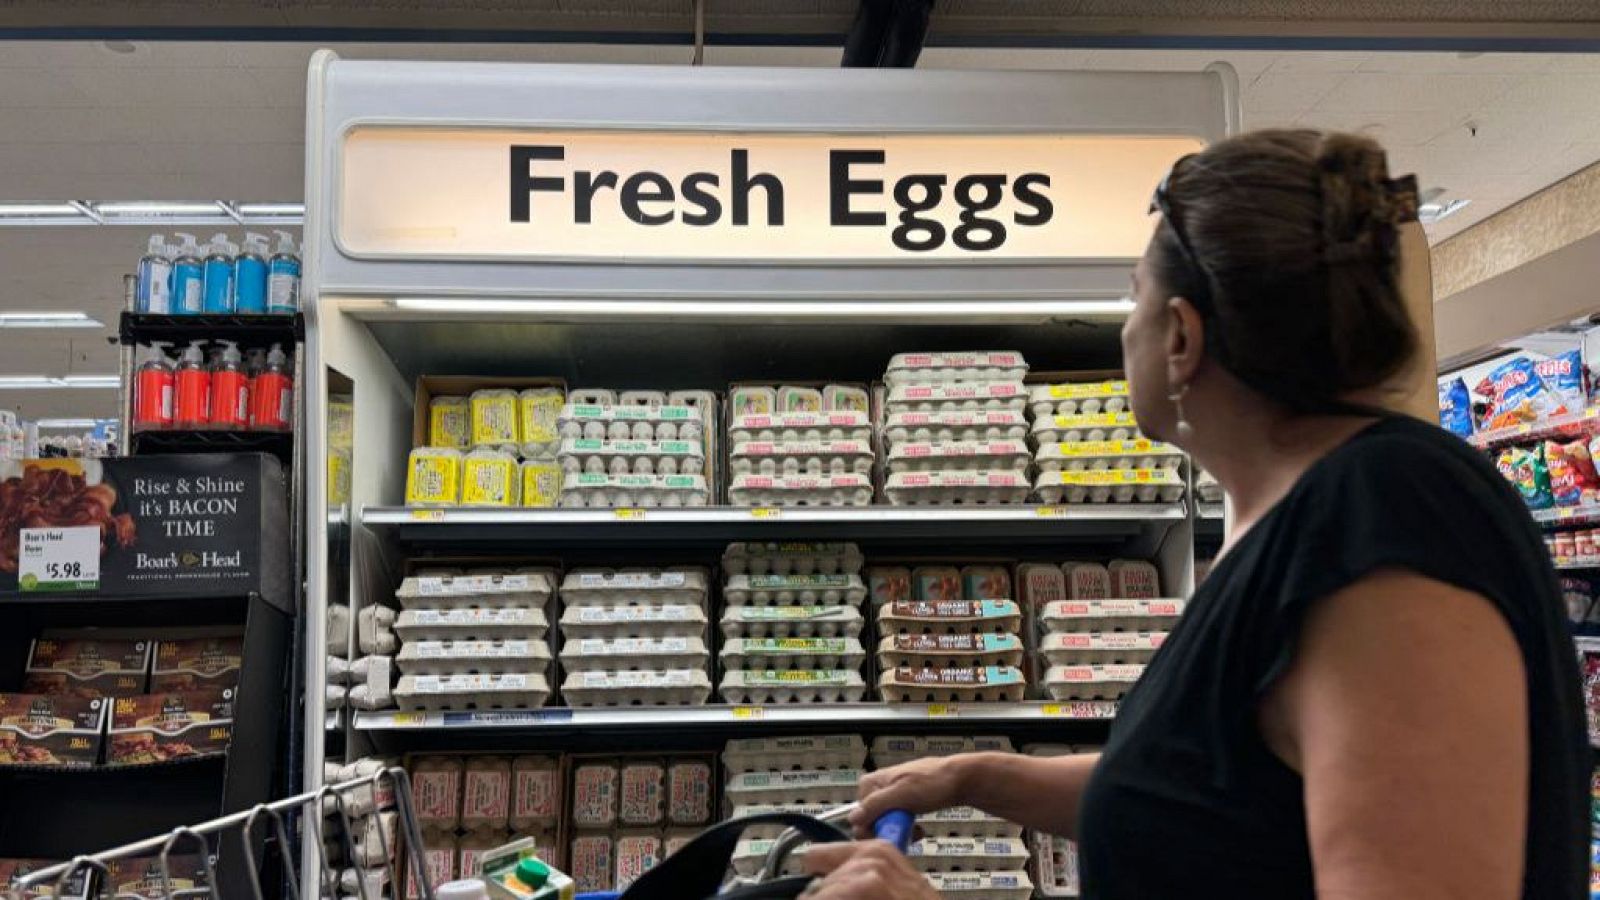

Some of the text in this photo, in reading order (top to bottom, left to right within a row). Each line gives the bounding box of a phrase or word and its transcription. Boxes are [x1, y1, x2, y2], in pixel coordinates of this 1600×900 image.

[509, 144, 1055, 253] Fresh Eggs
[135, 476, 245, 495] Rise & Shine
[140, 498, 237, 517] it's BACON
[162, 520, 215, 537] TIME
[136, 550, 240, 569] Boar's Head
